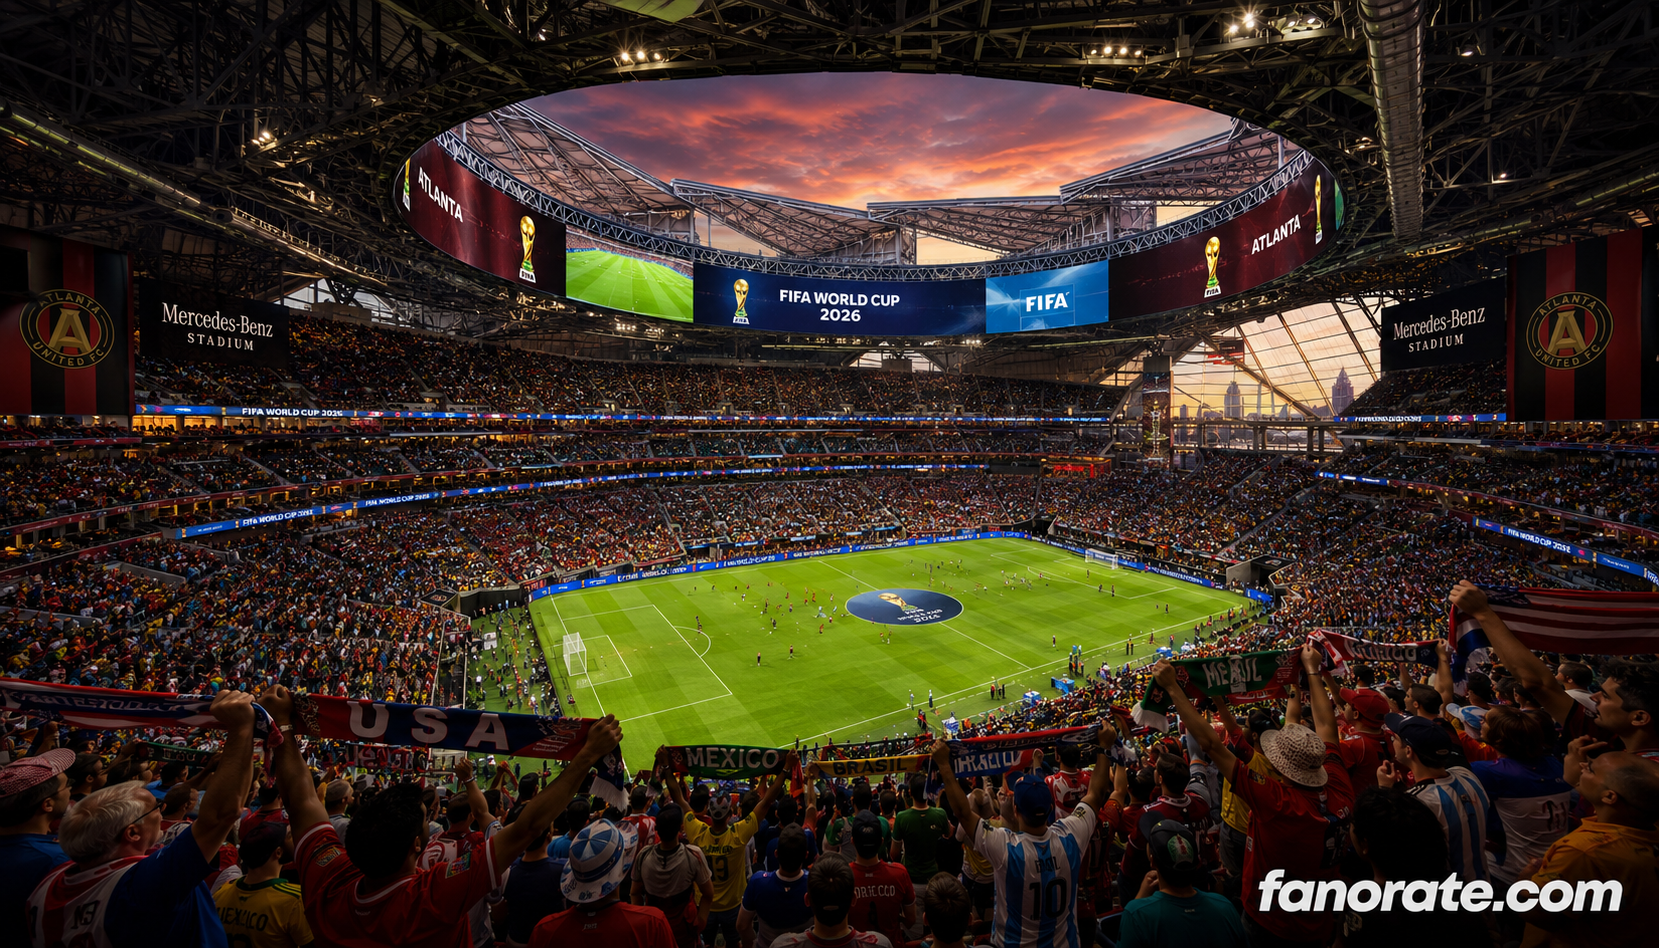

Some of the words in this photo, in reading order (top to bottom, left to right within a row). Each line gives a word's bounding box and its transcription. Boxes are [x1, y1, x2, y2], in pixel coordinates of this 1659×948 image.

[418, 166, 463, 223] ATLANTA
[1251, 214, 1301, 255] ATLANTA
[40, 292, 100, 314] ATLANTA
[780, 289, 811, 304] FIFA
[814, 292, 868, 306] WORLD
[871, 294, 900, 307] CUP
[1026, 292, 1069, 312] FIFA
[1539, 294, 1597, 316] ATLANTA
[162, 301, 273, 338] Mercedes-Benz
[820, 308, 861, 322] 2026
[1393, 307, 1485, 340] Mercedes-Benz
[187, 332, 254, 351] STADIUM
[1408, 333, 1464, 353] STADIUM
[1584, 344, 1600, 360] FC
[33, 341, 85, 367] UNITED
[89, 348, 105, 362] FC
[266, 408, 300, 416] WORLD
[301, 409, 320, 417] CUP
[346, 700, 510, 751] USA
[685, 746, 780, 770] MEXICO
[833, 757, 907, 775] BRASIL
[1029, 878, 1067, 920] 10
